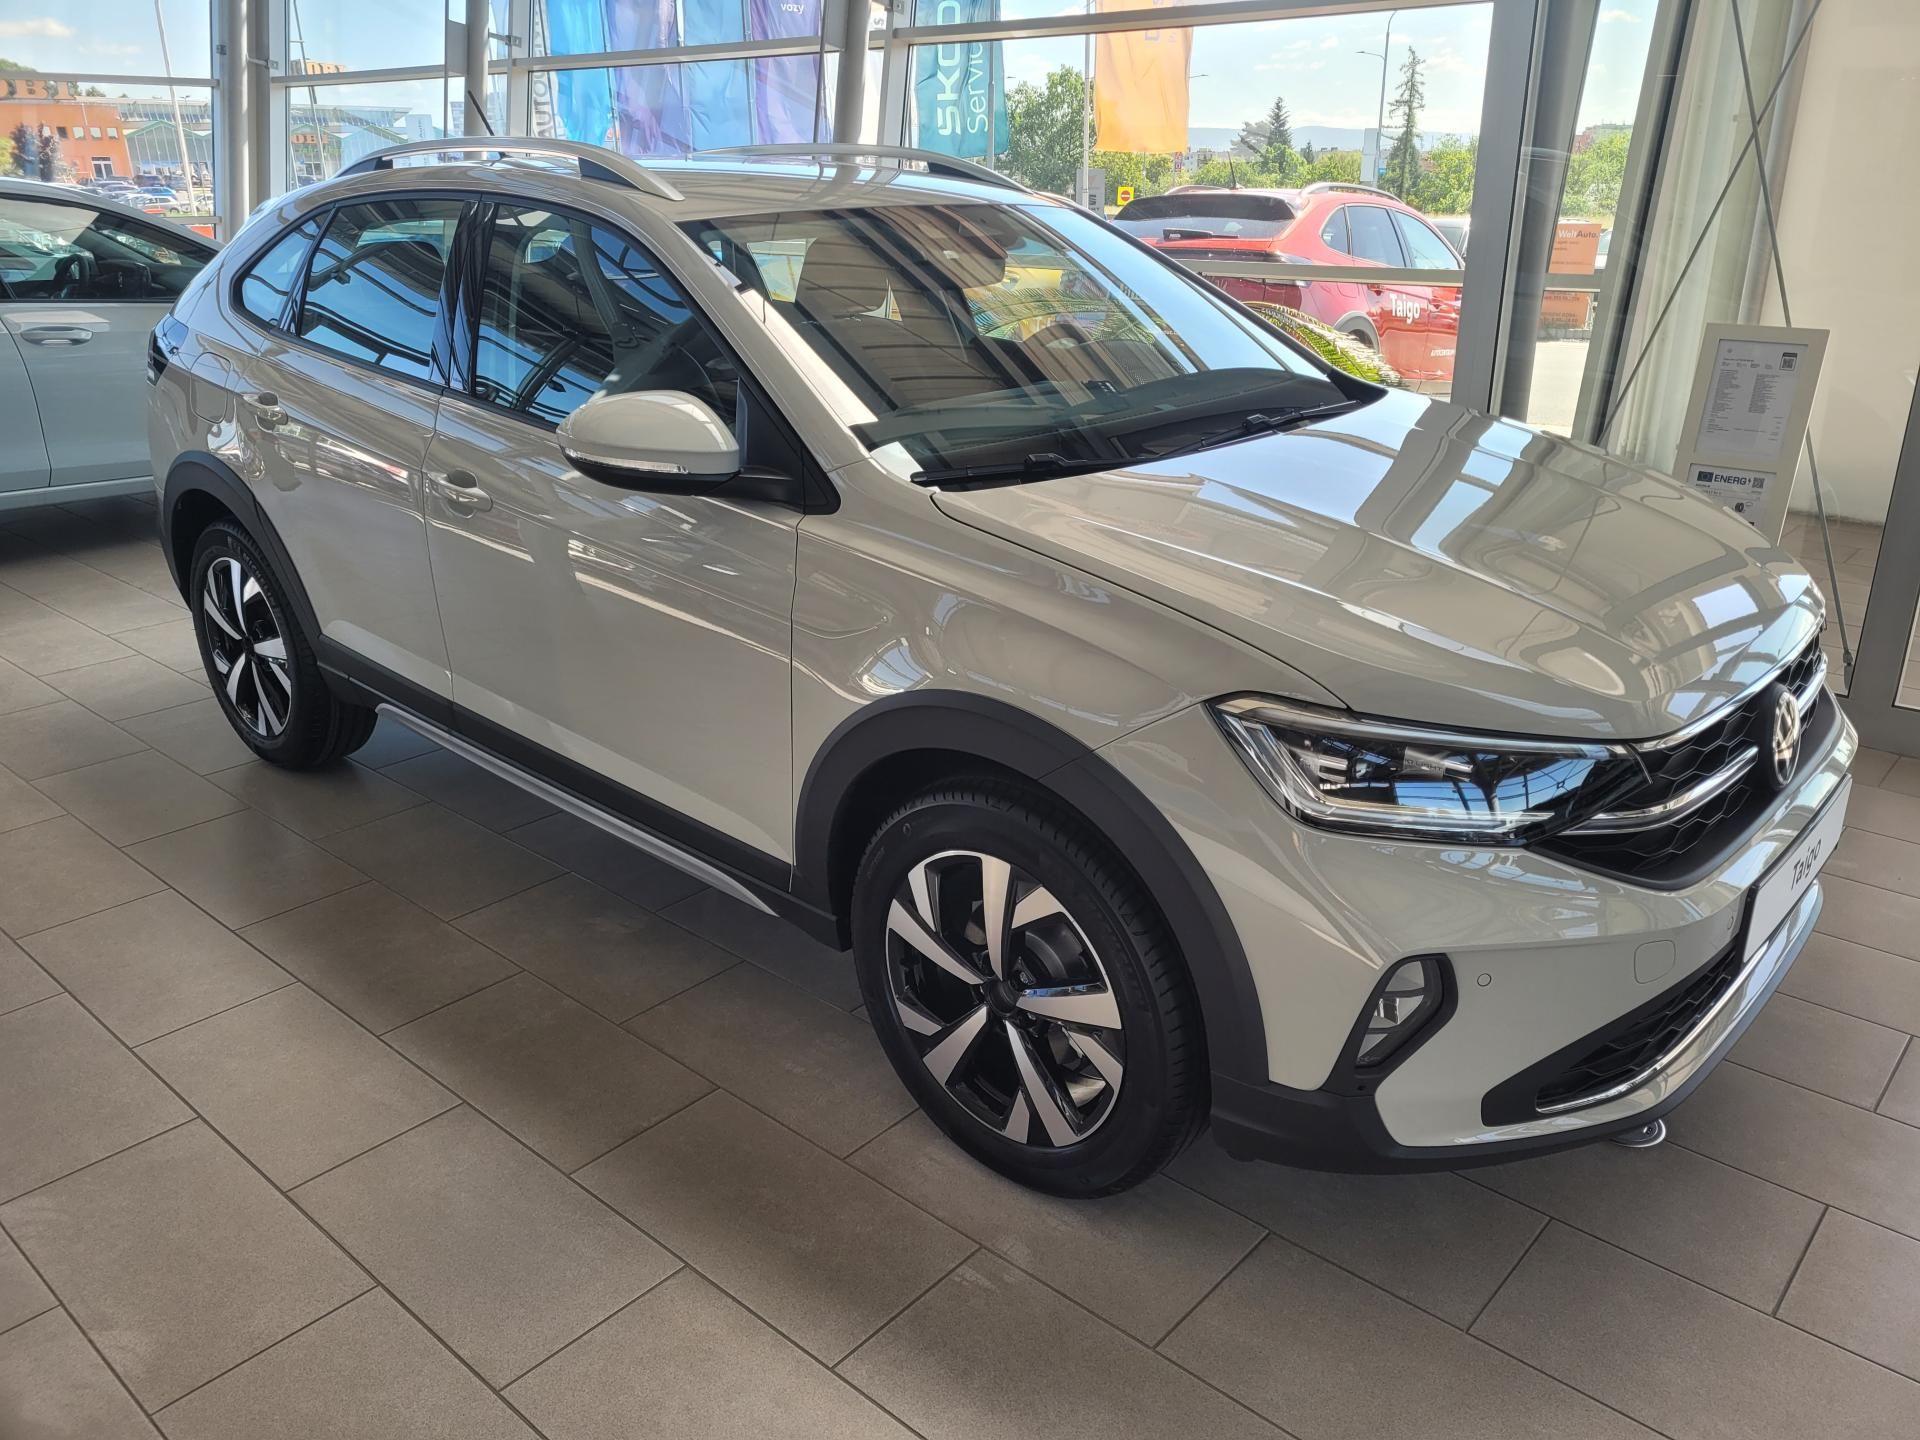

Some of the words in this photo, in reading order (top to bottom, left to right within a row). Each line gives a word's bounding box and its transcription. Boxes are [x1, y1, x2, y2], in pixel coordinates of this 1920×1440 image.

[1390, 293, 1420, 324] Taigo
[1713, 474, 1747, 486] ENERG
[1791, 838, 1821, 890] Taigo
